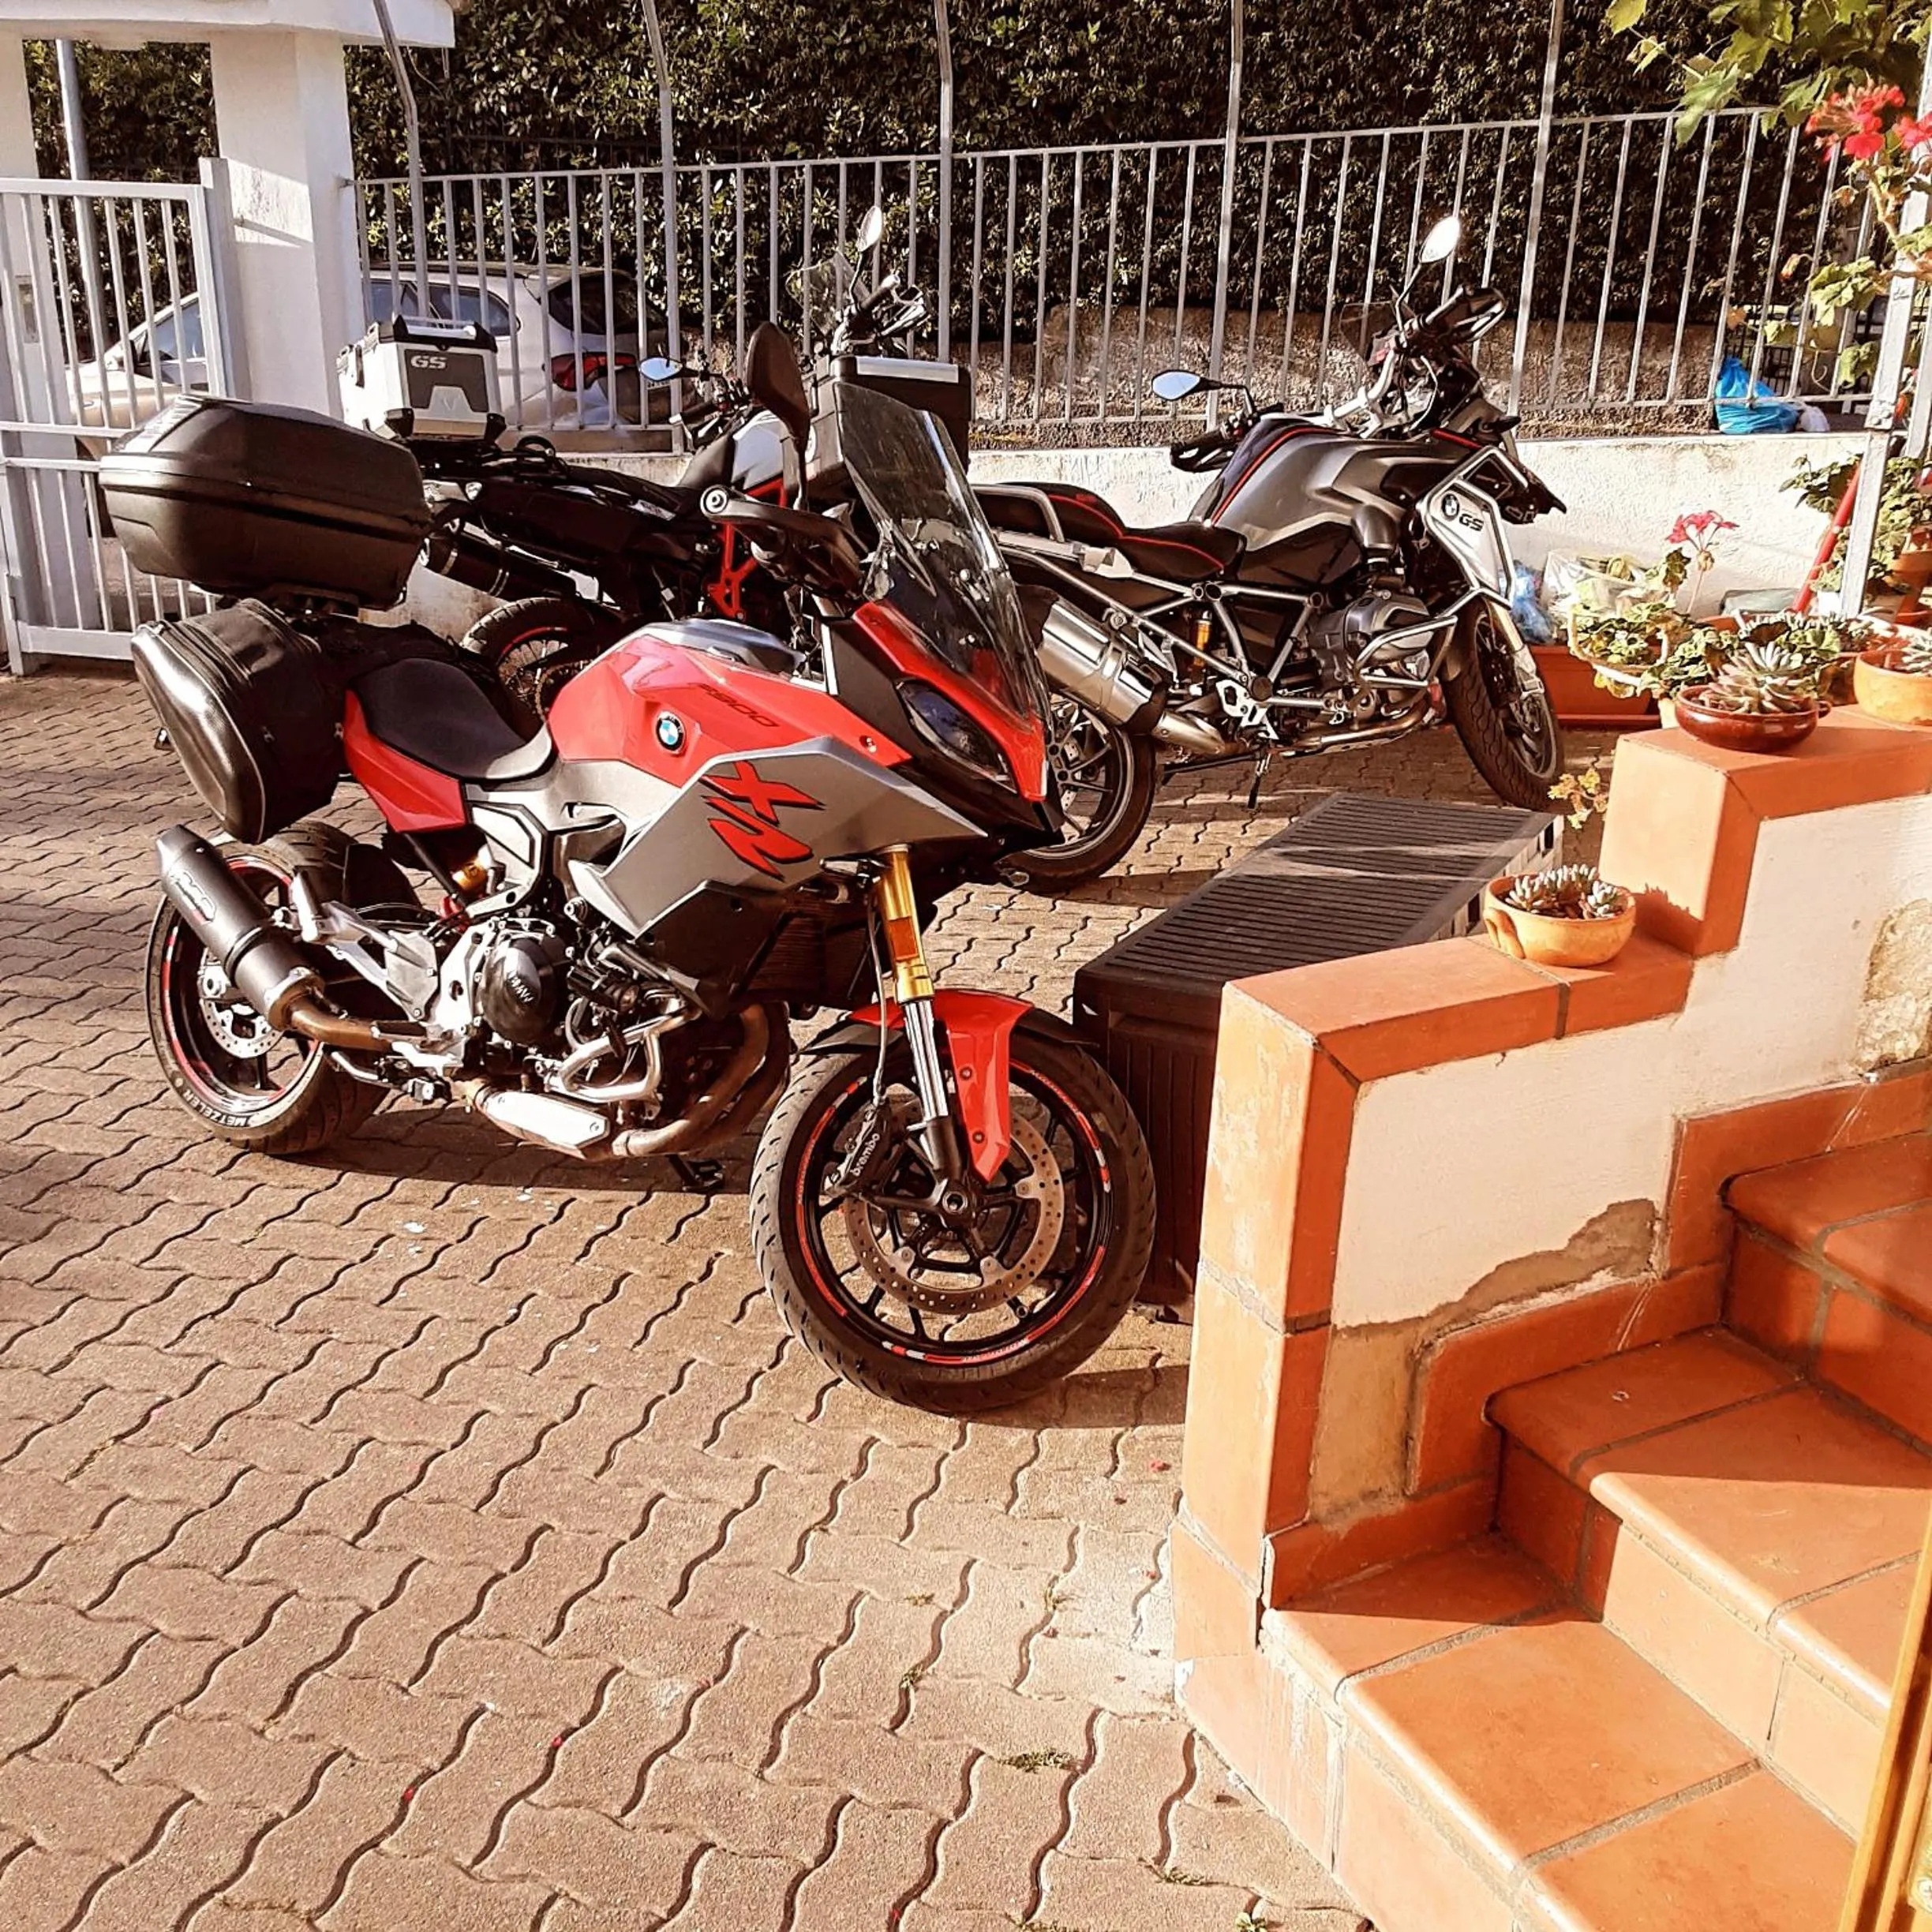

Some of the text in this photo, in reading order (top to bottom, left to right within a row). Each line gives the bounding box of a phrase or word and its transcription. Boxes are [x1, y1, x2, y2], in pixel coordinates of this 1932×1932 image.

[411, 354, 447, 369] GS
[1458, 513, 1485, 531] GS
[698, 760, 826, 883] XR
[508, 973, 534, 1002] BMW
[182, 1088, 247, 1127] METZELER
[849, 1133, 880, 1176] brembo
